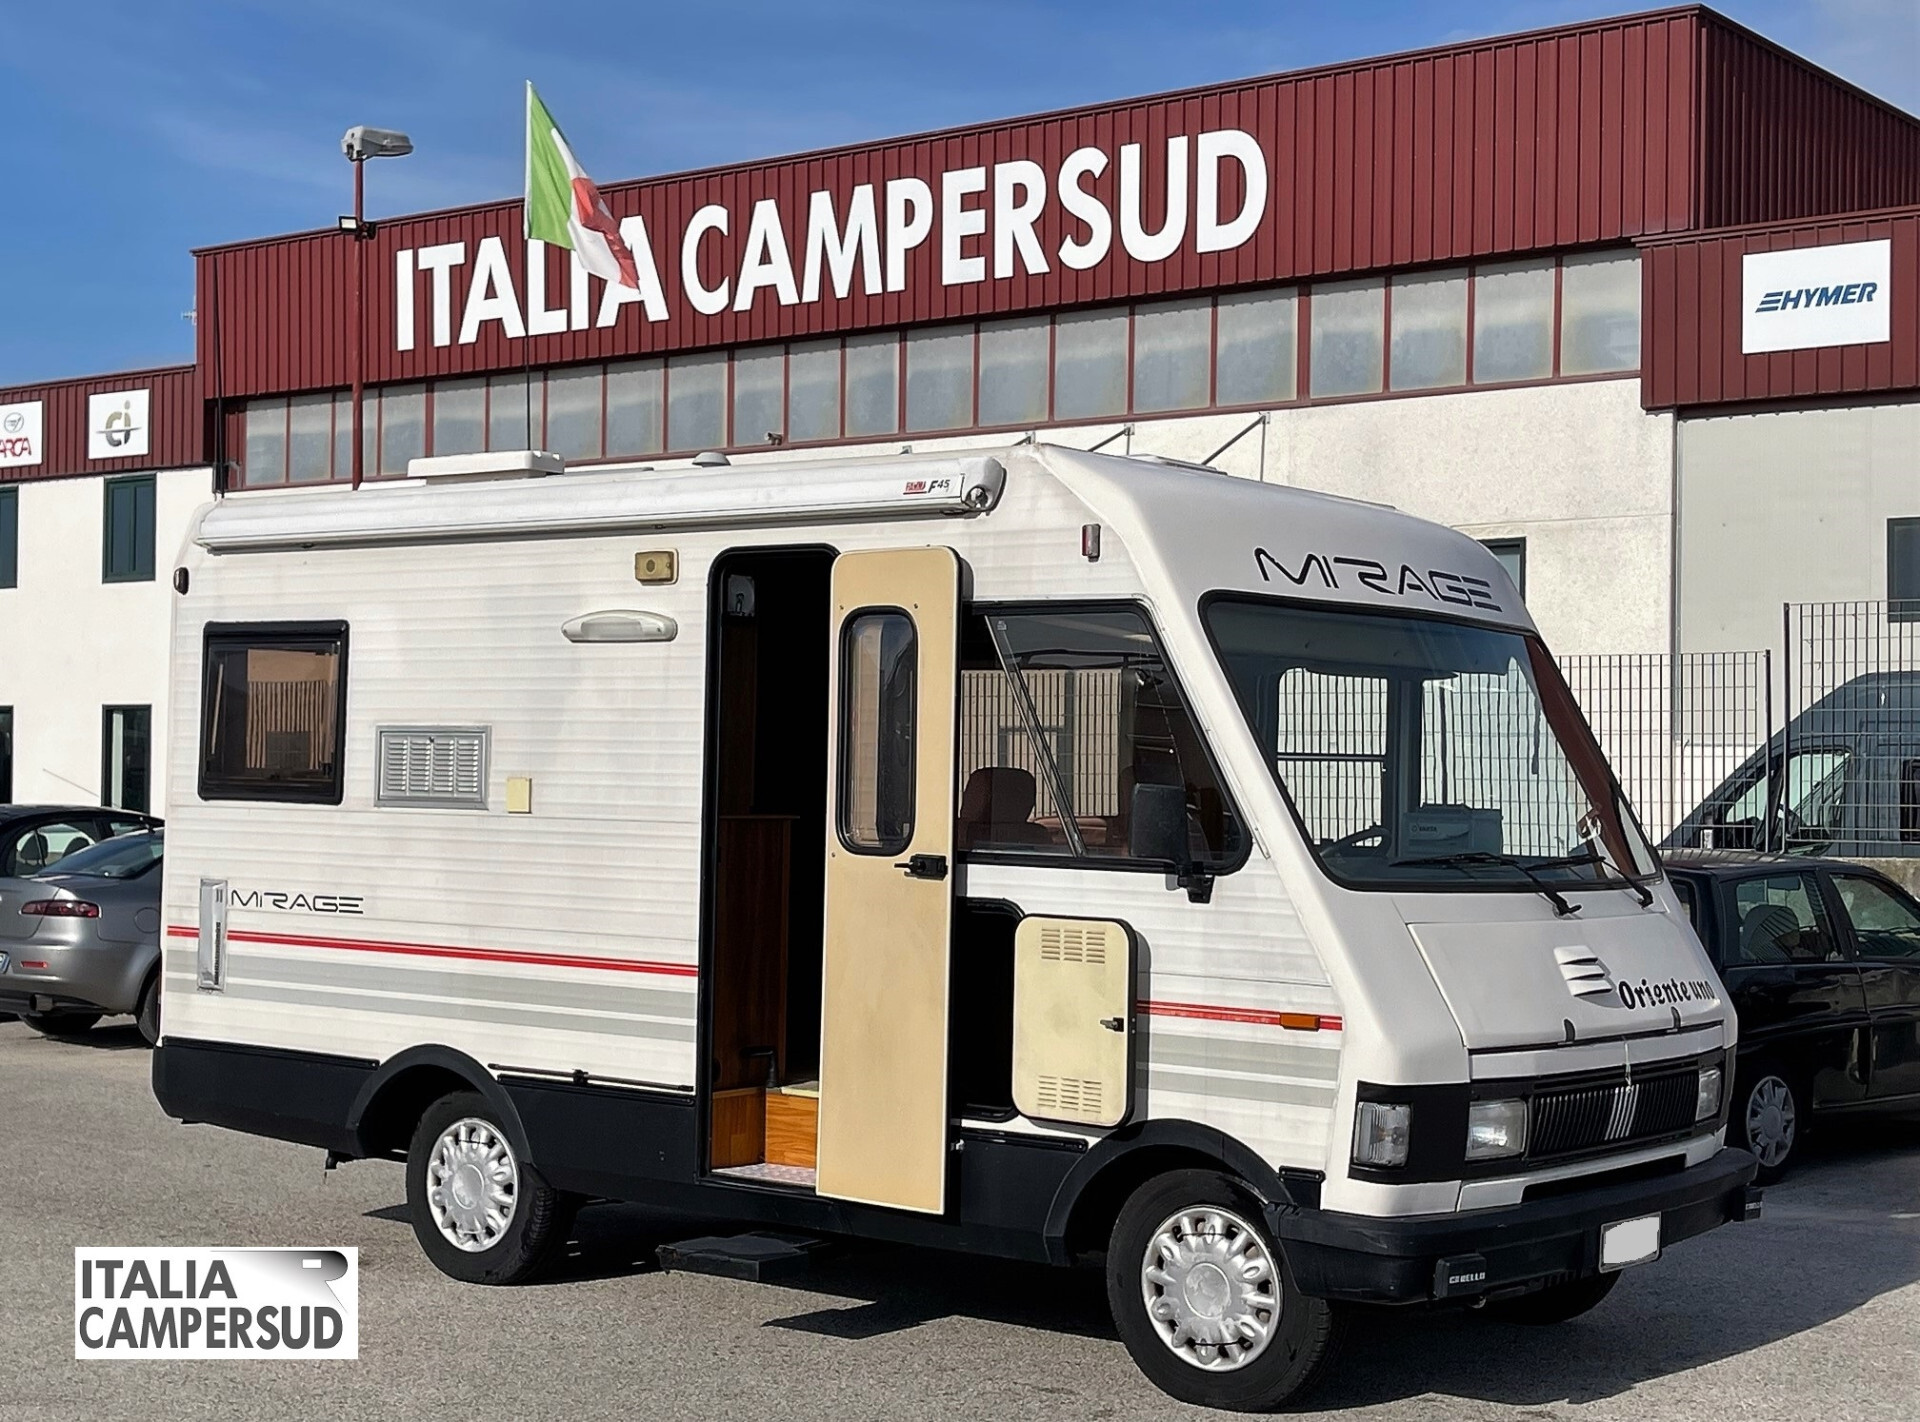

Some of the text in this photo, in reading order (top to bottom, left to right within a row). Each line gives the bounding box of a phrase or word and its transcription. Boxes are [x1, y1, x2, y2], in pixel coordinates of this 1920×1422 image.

[396, 129, 1268, 351] ITALIA CAMPERSUD
[1779, 281, 1878, 311] HYMER
[1254, 547, 1503, 613] MIRAGE
[231, 889, 364, 915] MIRAGE
[1618, 977, 1716, 1010] Oriente uno
